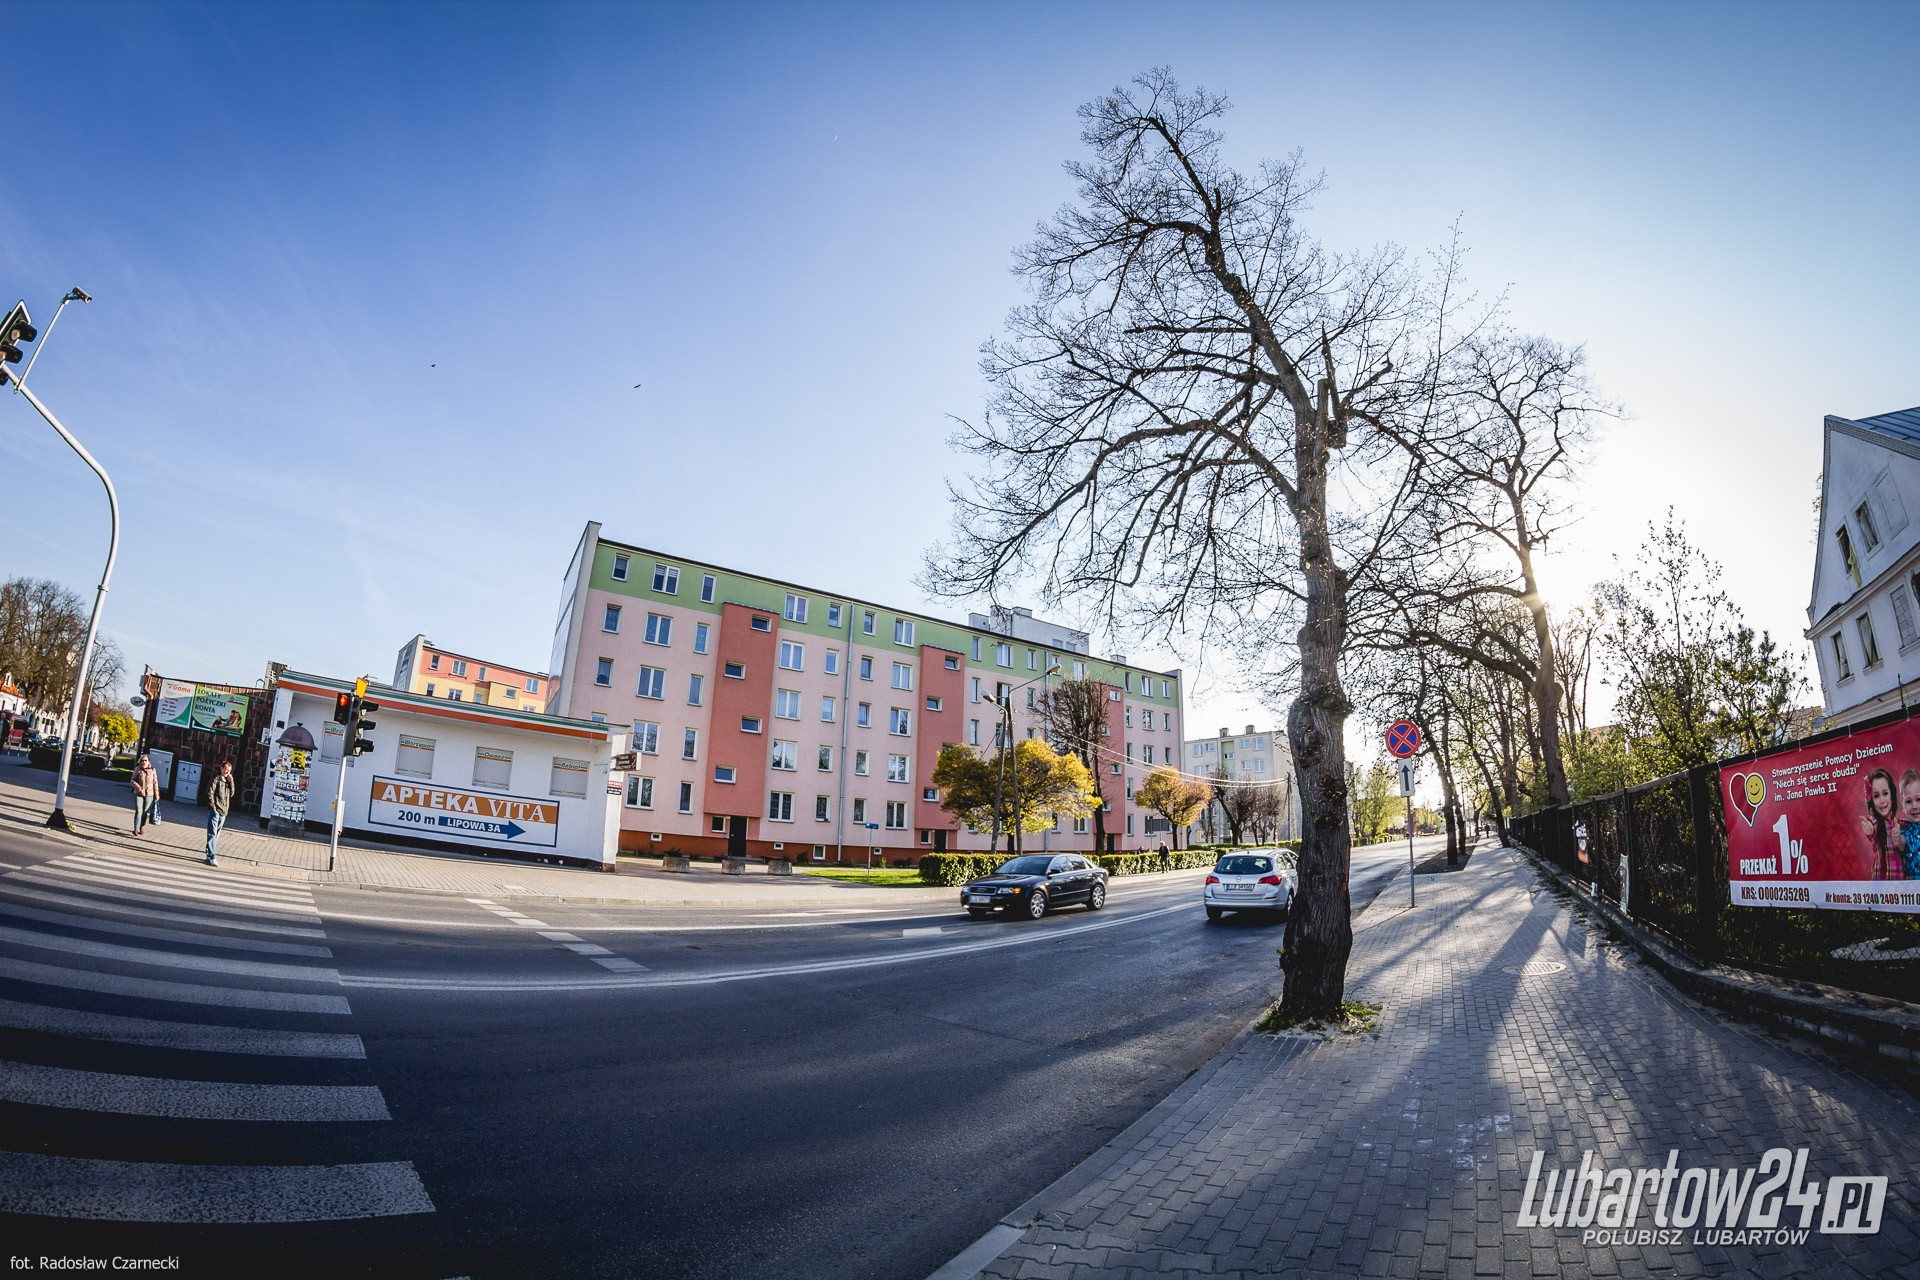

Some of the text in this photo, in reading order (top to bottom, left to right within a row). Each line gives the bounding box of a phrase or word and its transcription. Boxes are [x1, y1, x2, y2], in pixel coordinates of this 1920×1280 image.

[173, 685, 191, 693] Gama
[197, 689, 221, 698] LOKATY
[195, 704, 215, 713] KONTA
[196, 696, 226, 707] POŻYCZKI
[1772, 743, 1893, 778] Stowarzyszenie Pomocy Dzieciom
[1773, 763, 1860, 790] "Niech się serce obudzi"
[1774, 782, 1838, 802] im. Jana Pawła II
[381, 784, 547, 823] APTEKA VITA
[398, 810, 500, 833] 200 m LIPOWA 3A
[1740, 814, 1809, 875] PRZEKAŻ 1%
[1741, 887, 1757, 900] KRS:
[1758, 887, 1810, 902] 0000235289
[1825, 893, 1832, 903] Nr
[1833, 893, 1852, 904] konta:
[1852, 893, 1861, 905] 39
[1862, 893, 1879, 905] 1240
[1880, 893, 1899, 905] 2409
[1900, 893, 1915, 906] 1111
